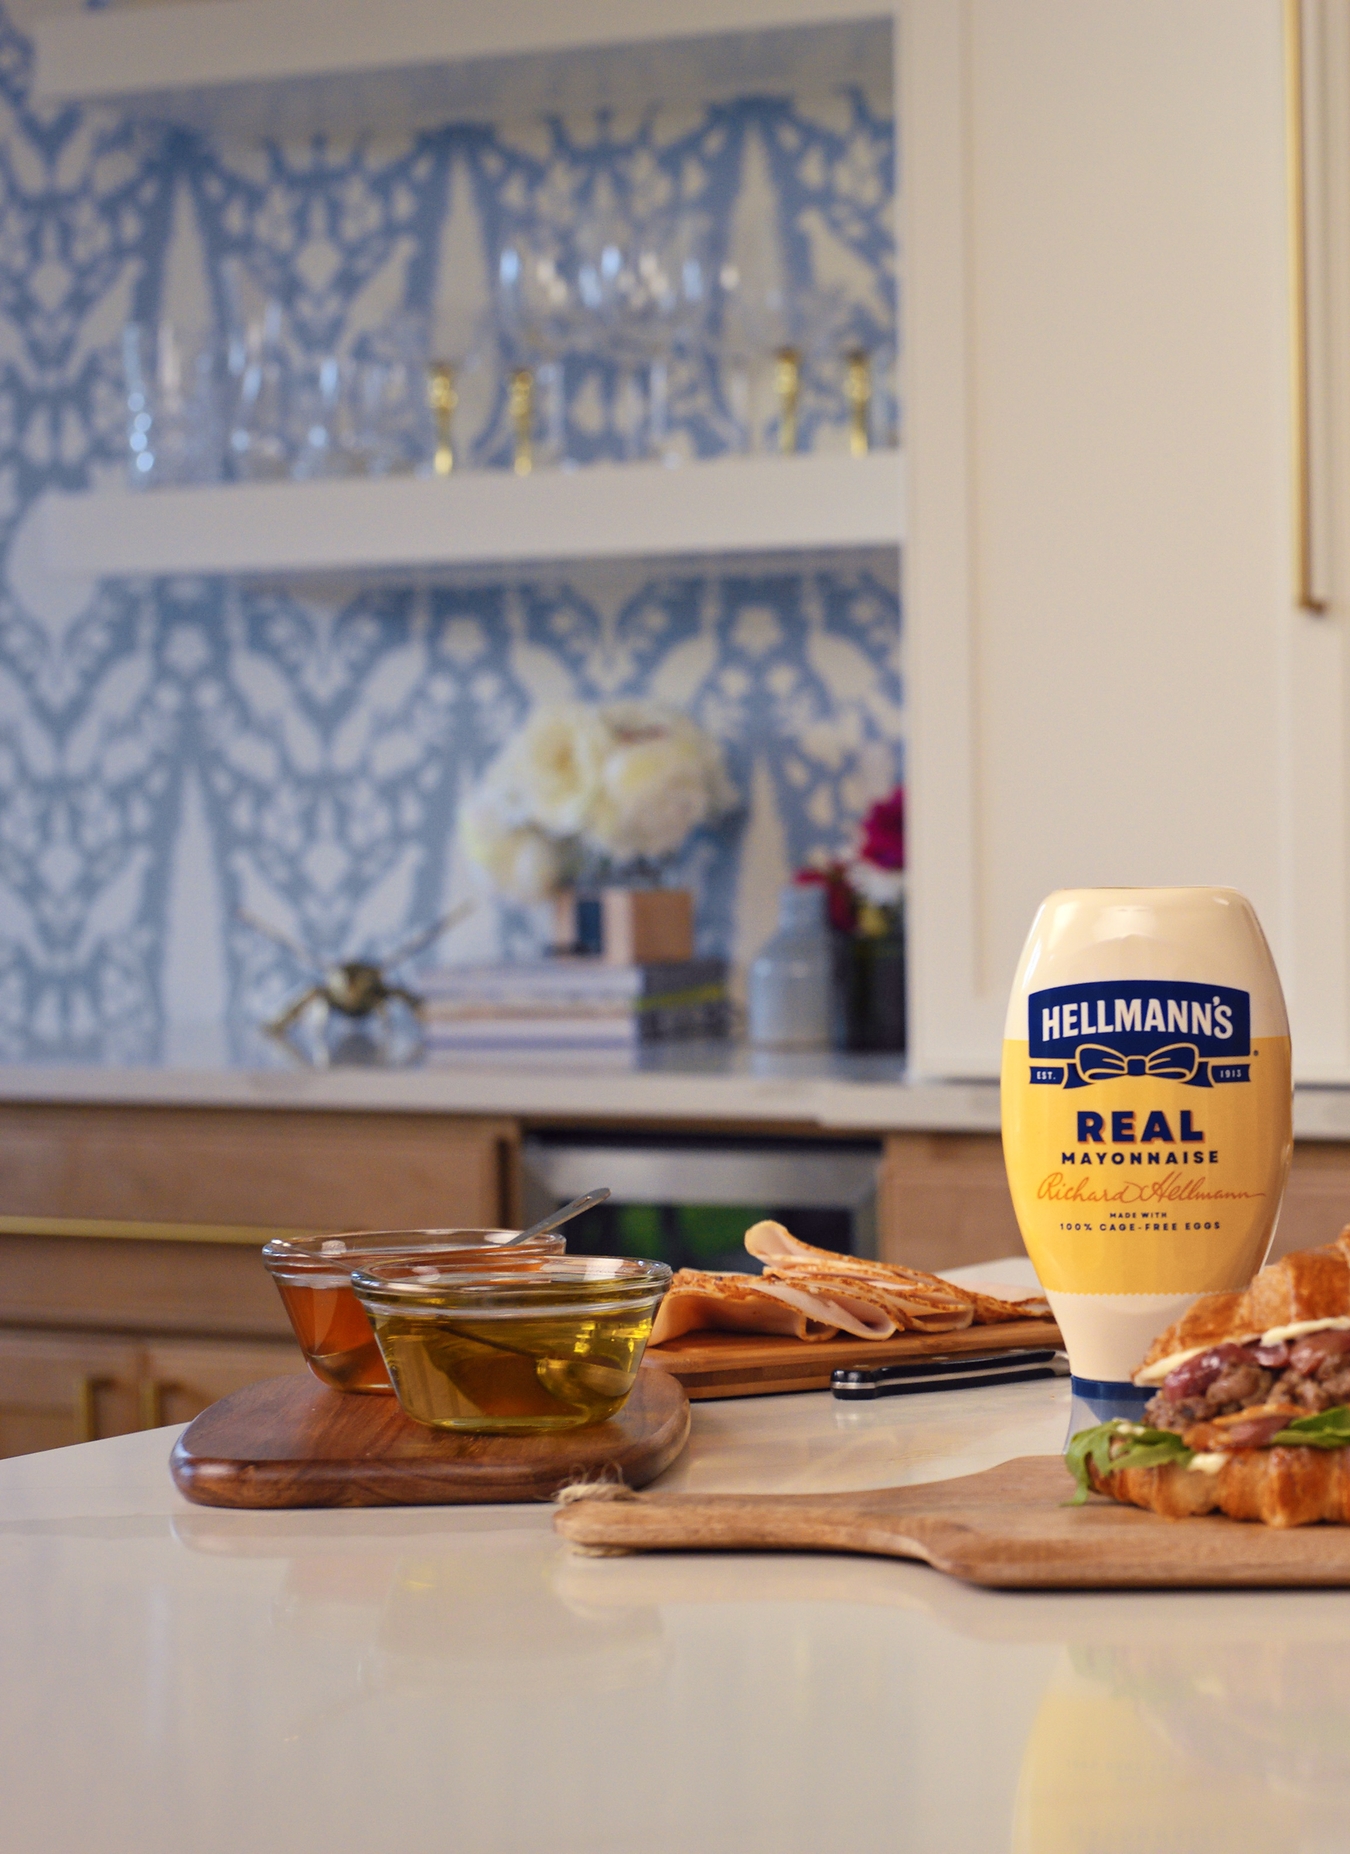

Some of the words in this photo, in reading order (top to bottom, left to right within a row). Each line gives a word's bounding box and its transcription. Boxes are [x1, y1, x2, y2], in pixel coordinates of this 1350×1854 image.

[1042, 996, 1234, 1041] HELLMANN'S
[1036, 1071, 1056, 1080] EST.
[1220, 1069, 1242, 1078] 1913
[1076, 1110, 1205, 1144] REAL
[1061, 1151, 1219, 1165] MAYONNAISE
[1037, 1172, 1142, 1203] Richard
[1139, 1171, 1265, 1203] Hellmann
[1060, 1223, 1092, 1231] 100%
[1099, 1222, 1177, 1231] CAGE-FREE
[1185, 1221, 1220, 1230] EGGS
